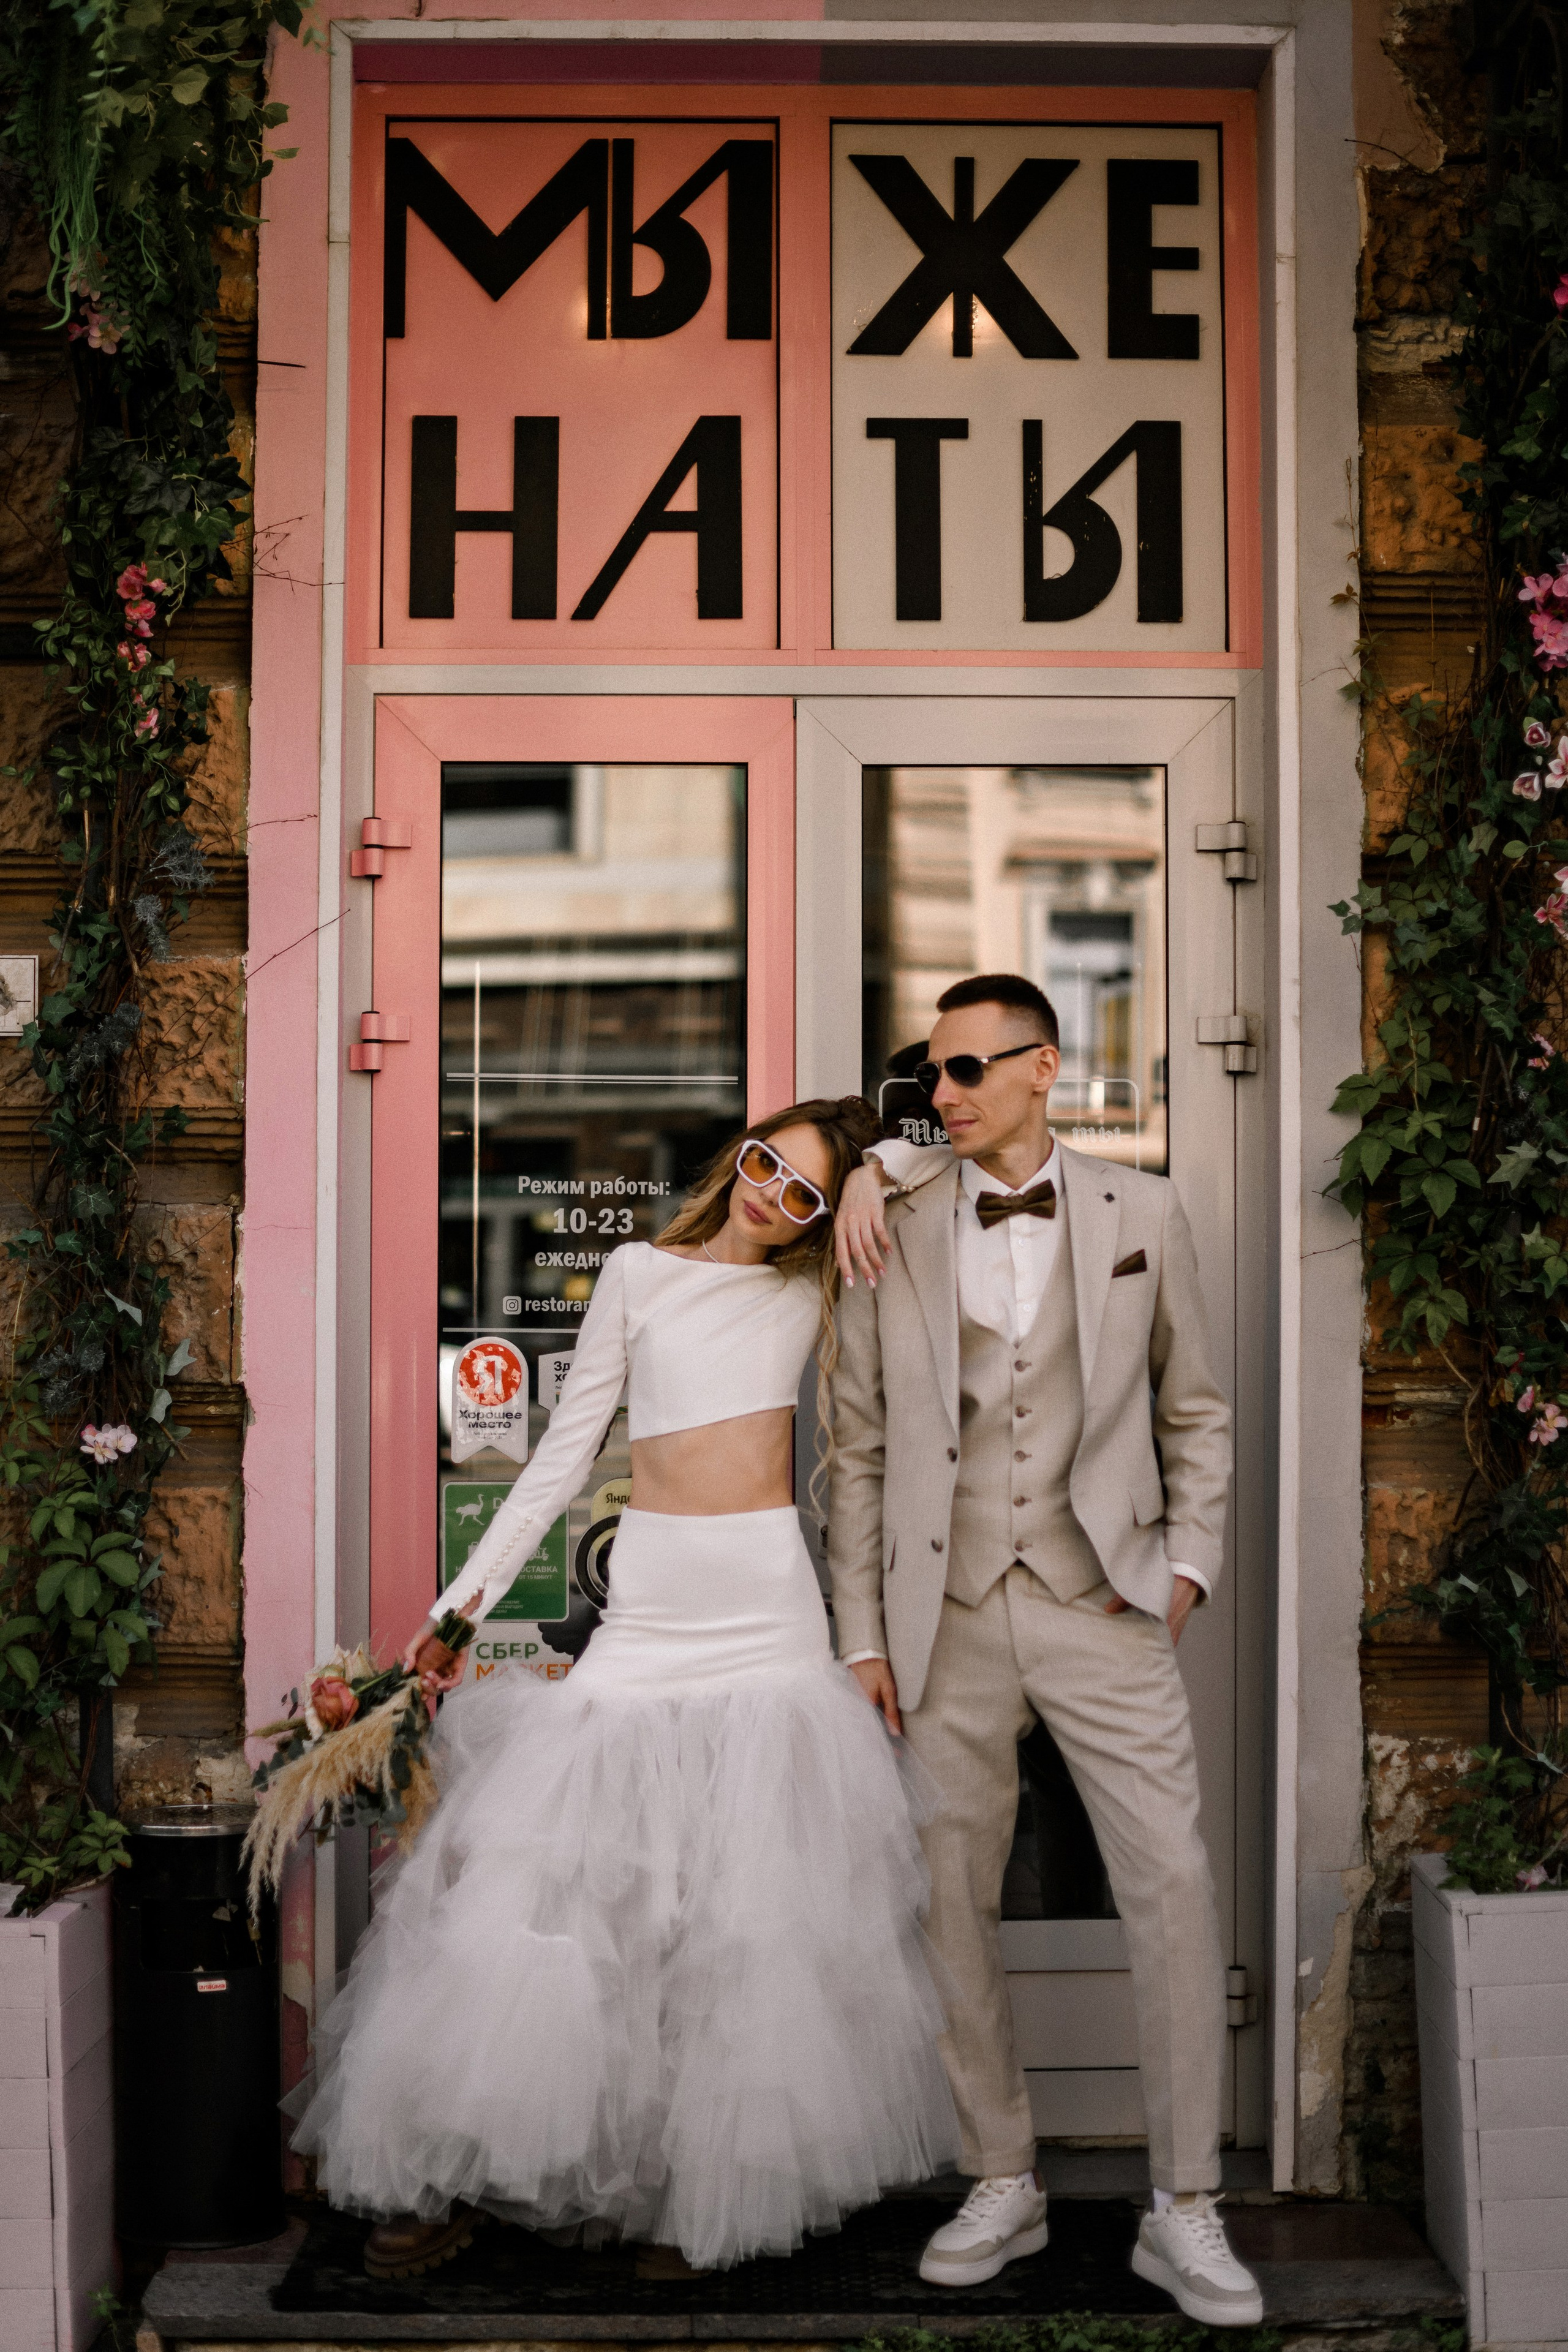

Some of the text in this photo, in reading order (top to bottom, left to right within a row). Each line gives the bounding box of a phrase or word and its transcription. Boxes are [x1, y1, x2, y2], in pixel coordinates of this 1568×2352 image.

[385, 137, 1200, 359] МЫ ЖЕ
[409, 415, 1183, 622] НА ТЫ
[518, 1175, 670, 1199] Режим работы:
[553, 1207, 634, 1234] 10-23
[458, 1410, 522, 1420] Хорошее
[475, 1642, 539, 1659] СБЕР
